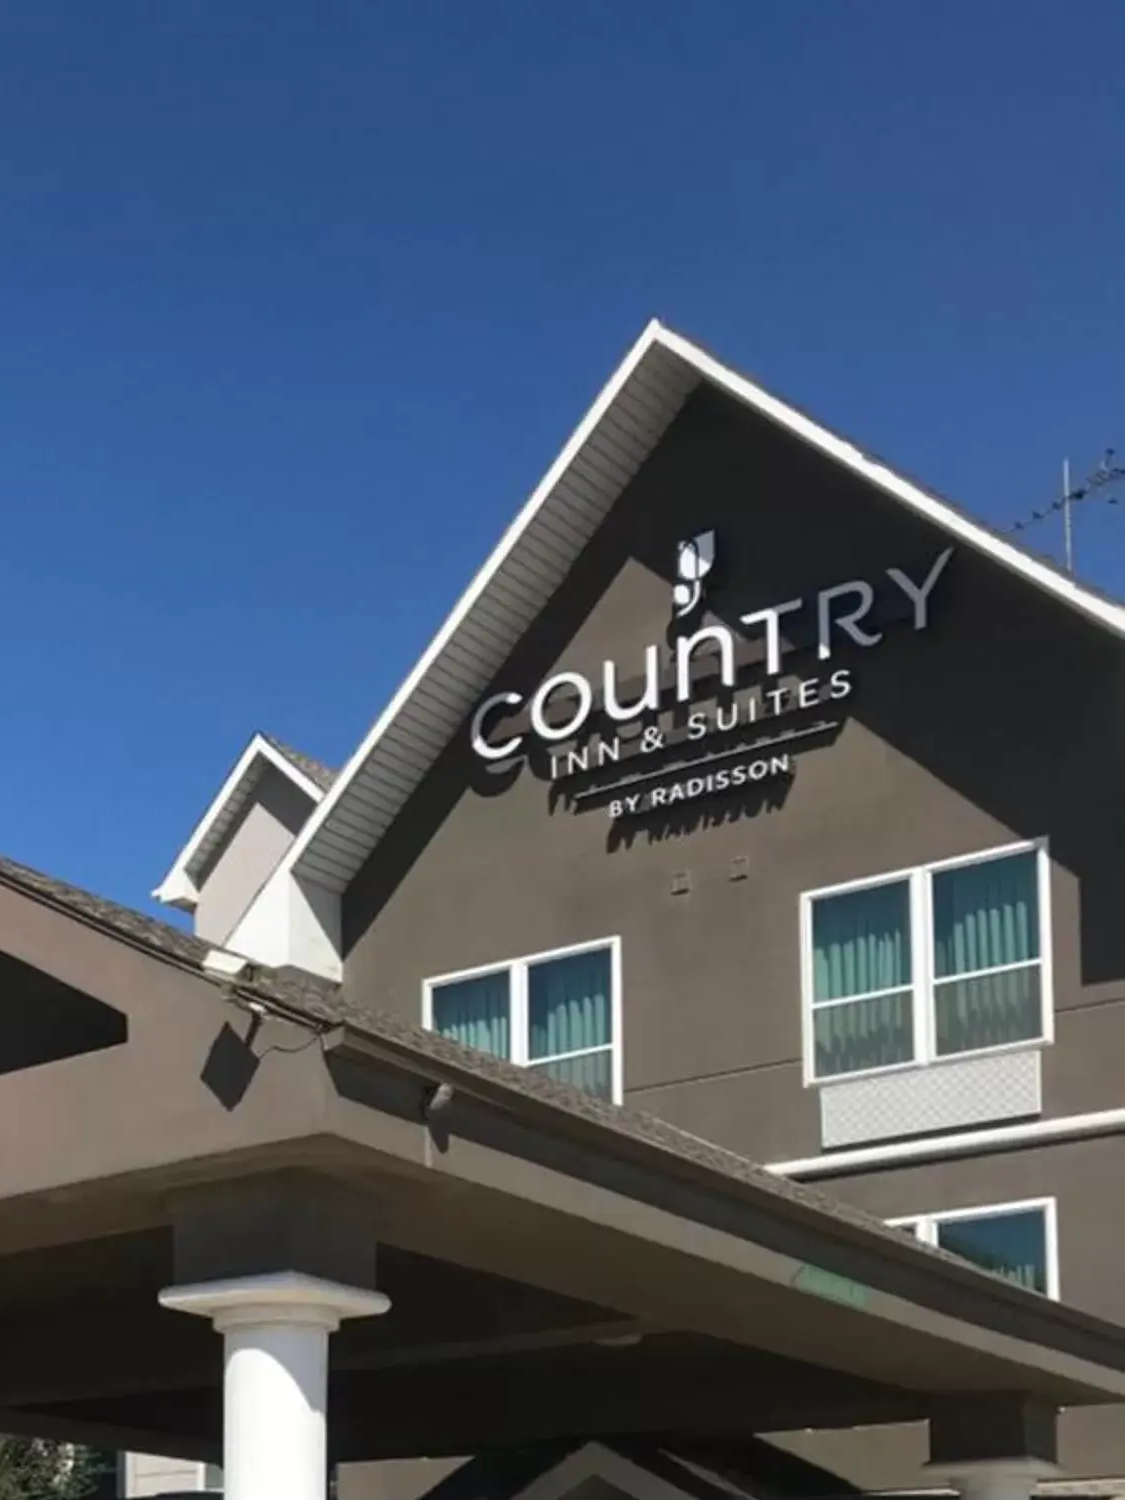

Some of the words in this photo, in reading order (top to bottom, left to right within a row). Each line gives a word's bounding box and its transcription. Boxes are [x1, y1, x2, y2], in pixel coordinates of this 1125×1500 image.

[551, 737, 620, 779] INN
[641, 727, 665, 753] &
[687, 669, 852, 740] SUITES
[609, 794, 641, 818] BY
[651, 753, 790, 807] RADISSON
